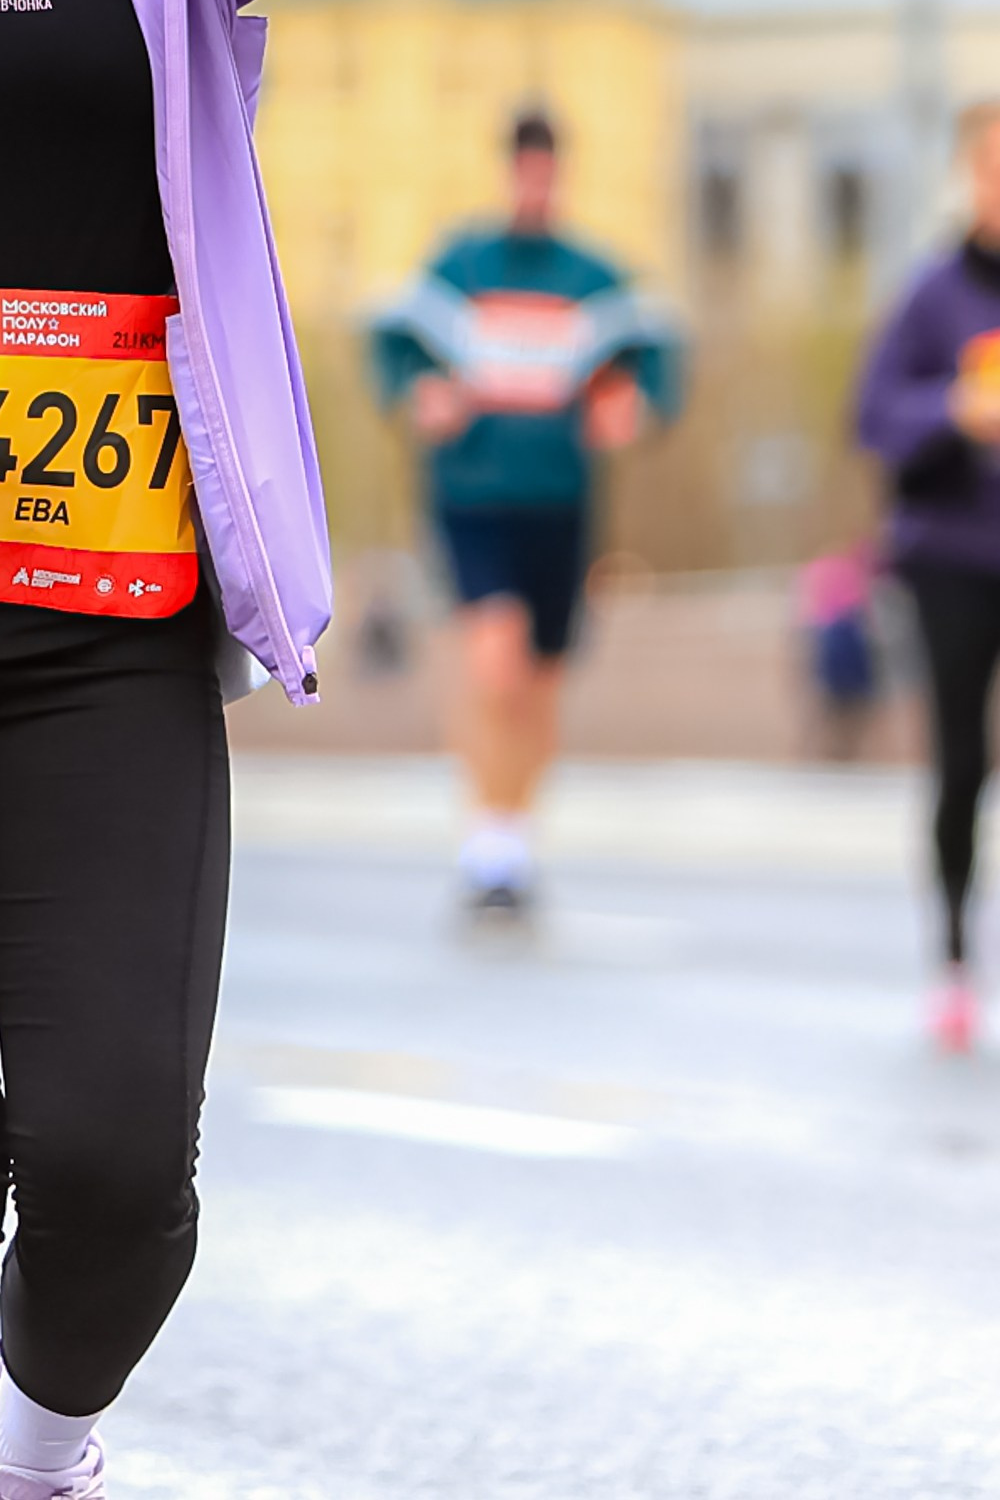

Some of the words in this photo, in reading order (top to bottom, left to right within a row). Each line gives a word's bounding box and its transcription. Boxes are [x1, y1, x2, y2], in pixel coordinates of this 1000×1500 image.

[1, 299, 107, 318] МОСКОВСКИЙ
[2, 331, 80, 348] МАРАФОН
[14, 497, 70, 525] ЕВА
